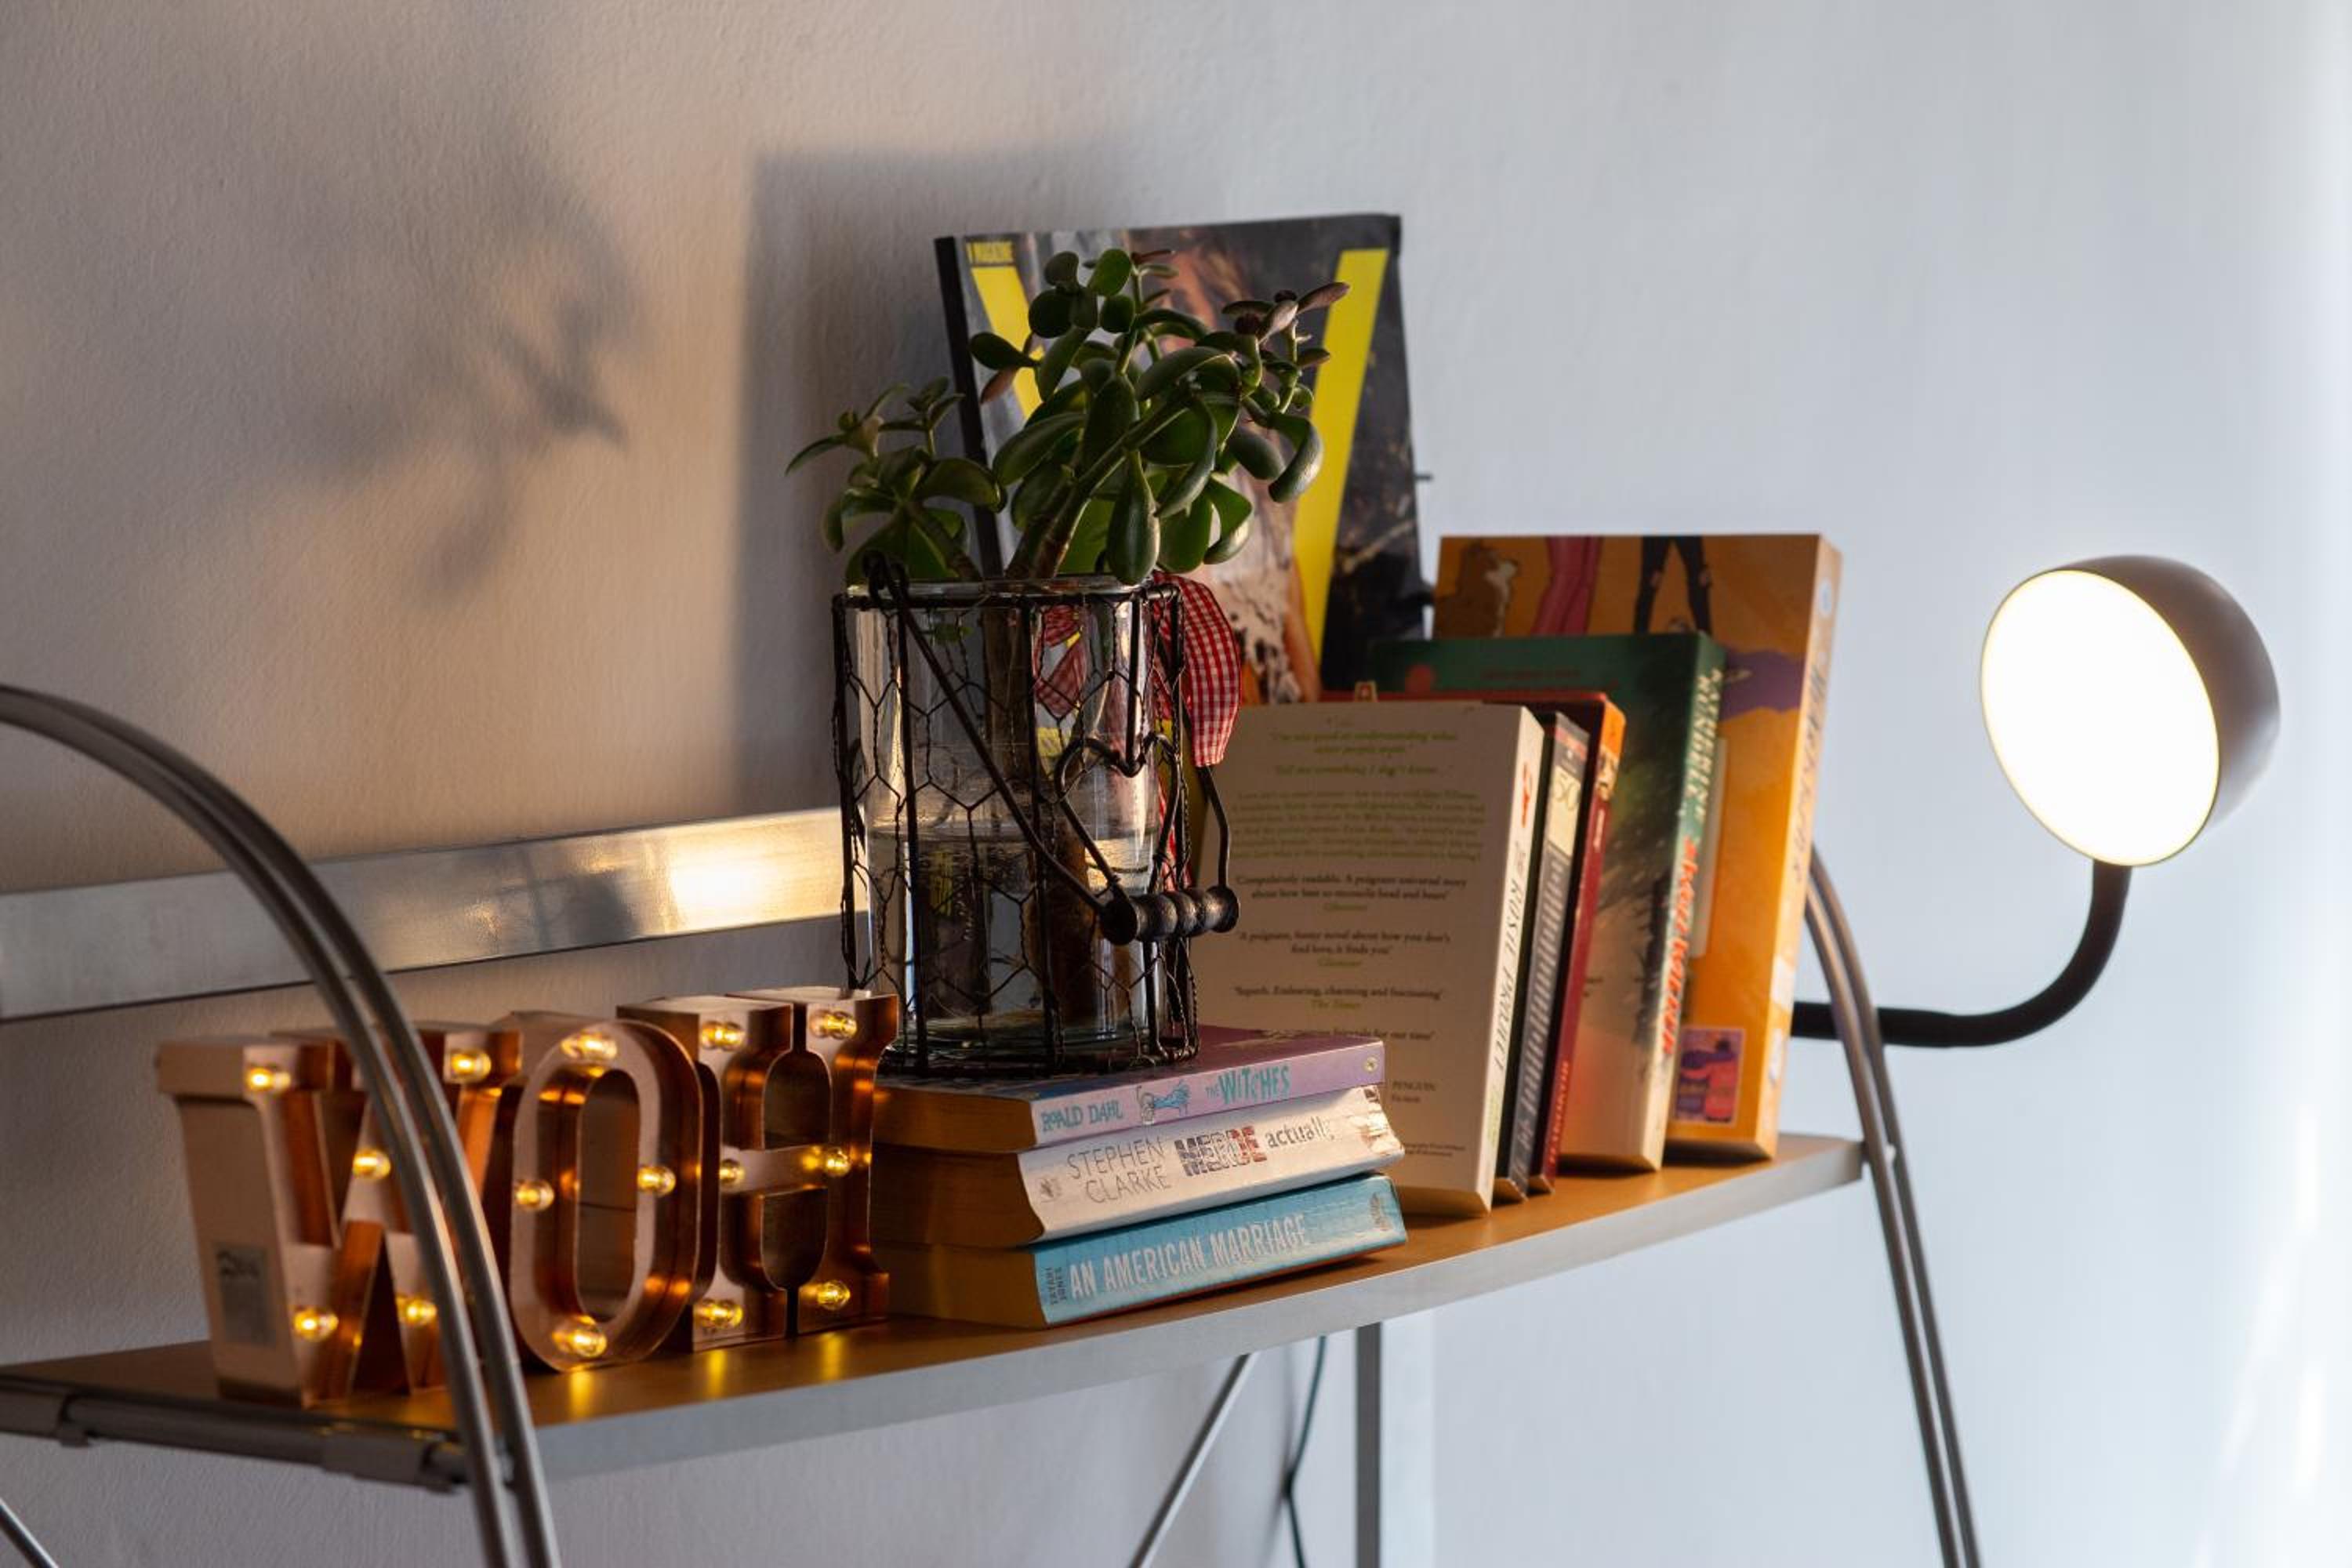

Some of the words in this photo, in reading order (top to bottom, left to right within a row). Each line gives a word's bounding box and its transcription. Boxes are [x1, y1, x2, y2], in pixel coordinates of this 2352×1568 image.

[1218, 1065, 1291, 1104] WITCHES
[1041, 1105, 1083, 1132] ROALD
[1087, 1100, 1123, 1124] DAHL
[1067, 1136, 1166, 1180] STEPHEN
[1085, 1165, 1172, 1203] CLARKE
[1069, 1261, 1097, 1298] AN
[1103, 1235, 1206, 1291] AMERICAN
[1208, 1214, 1306, 1269] MARRIAGE
